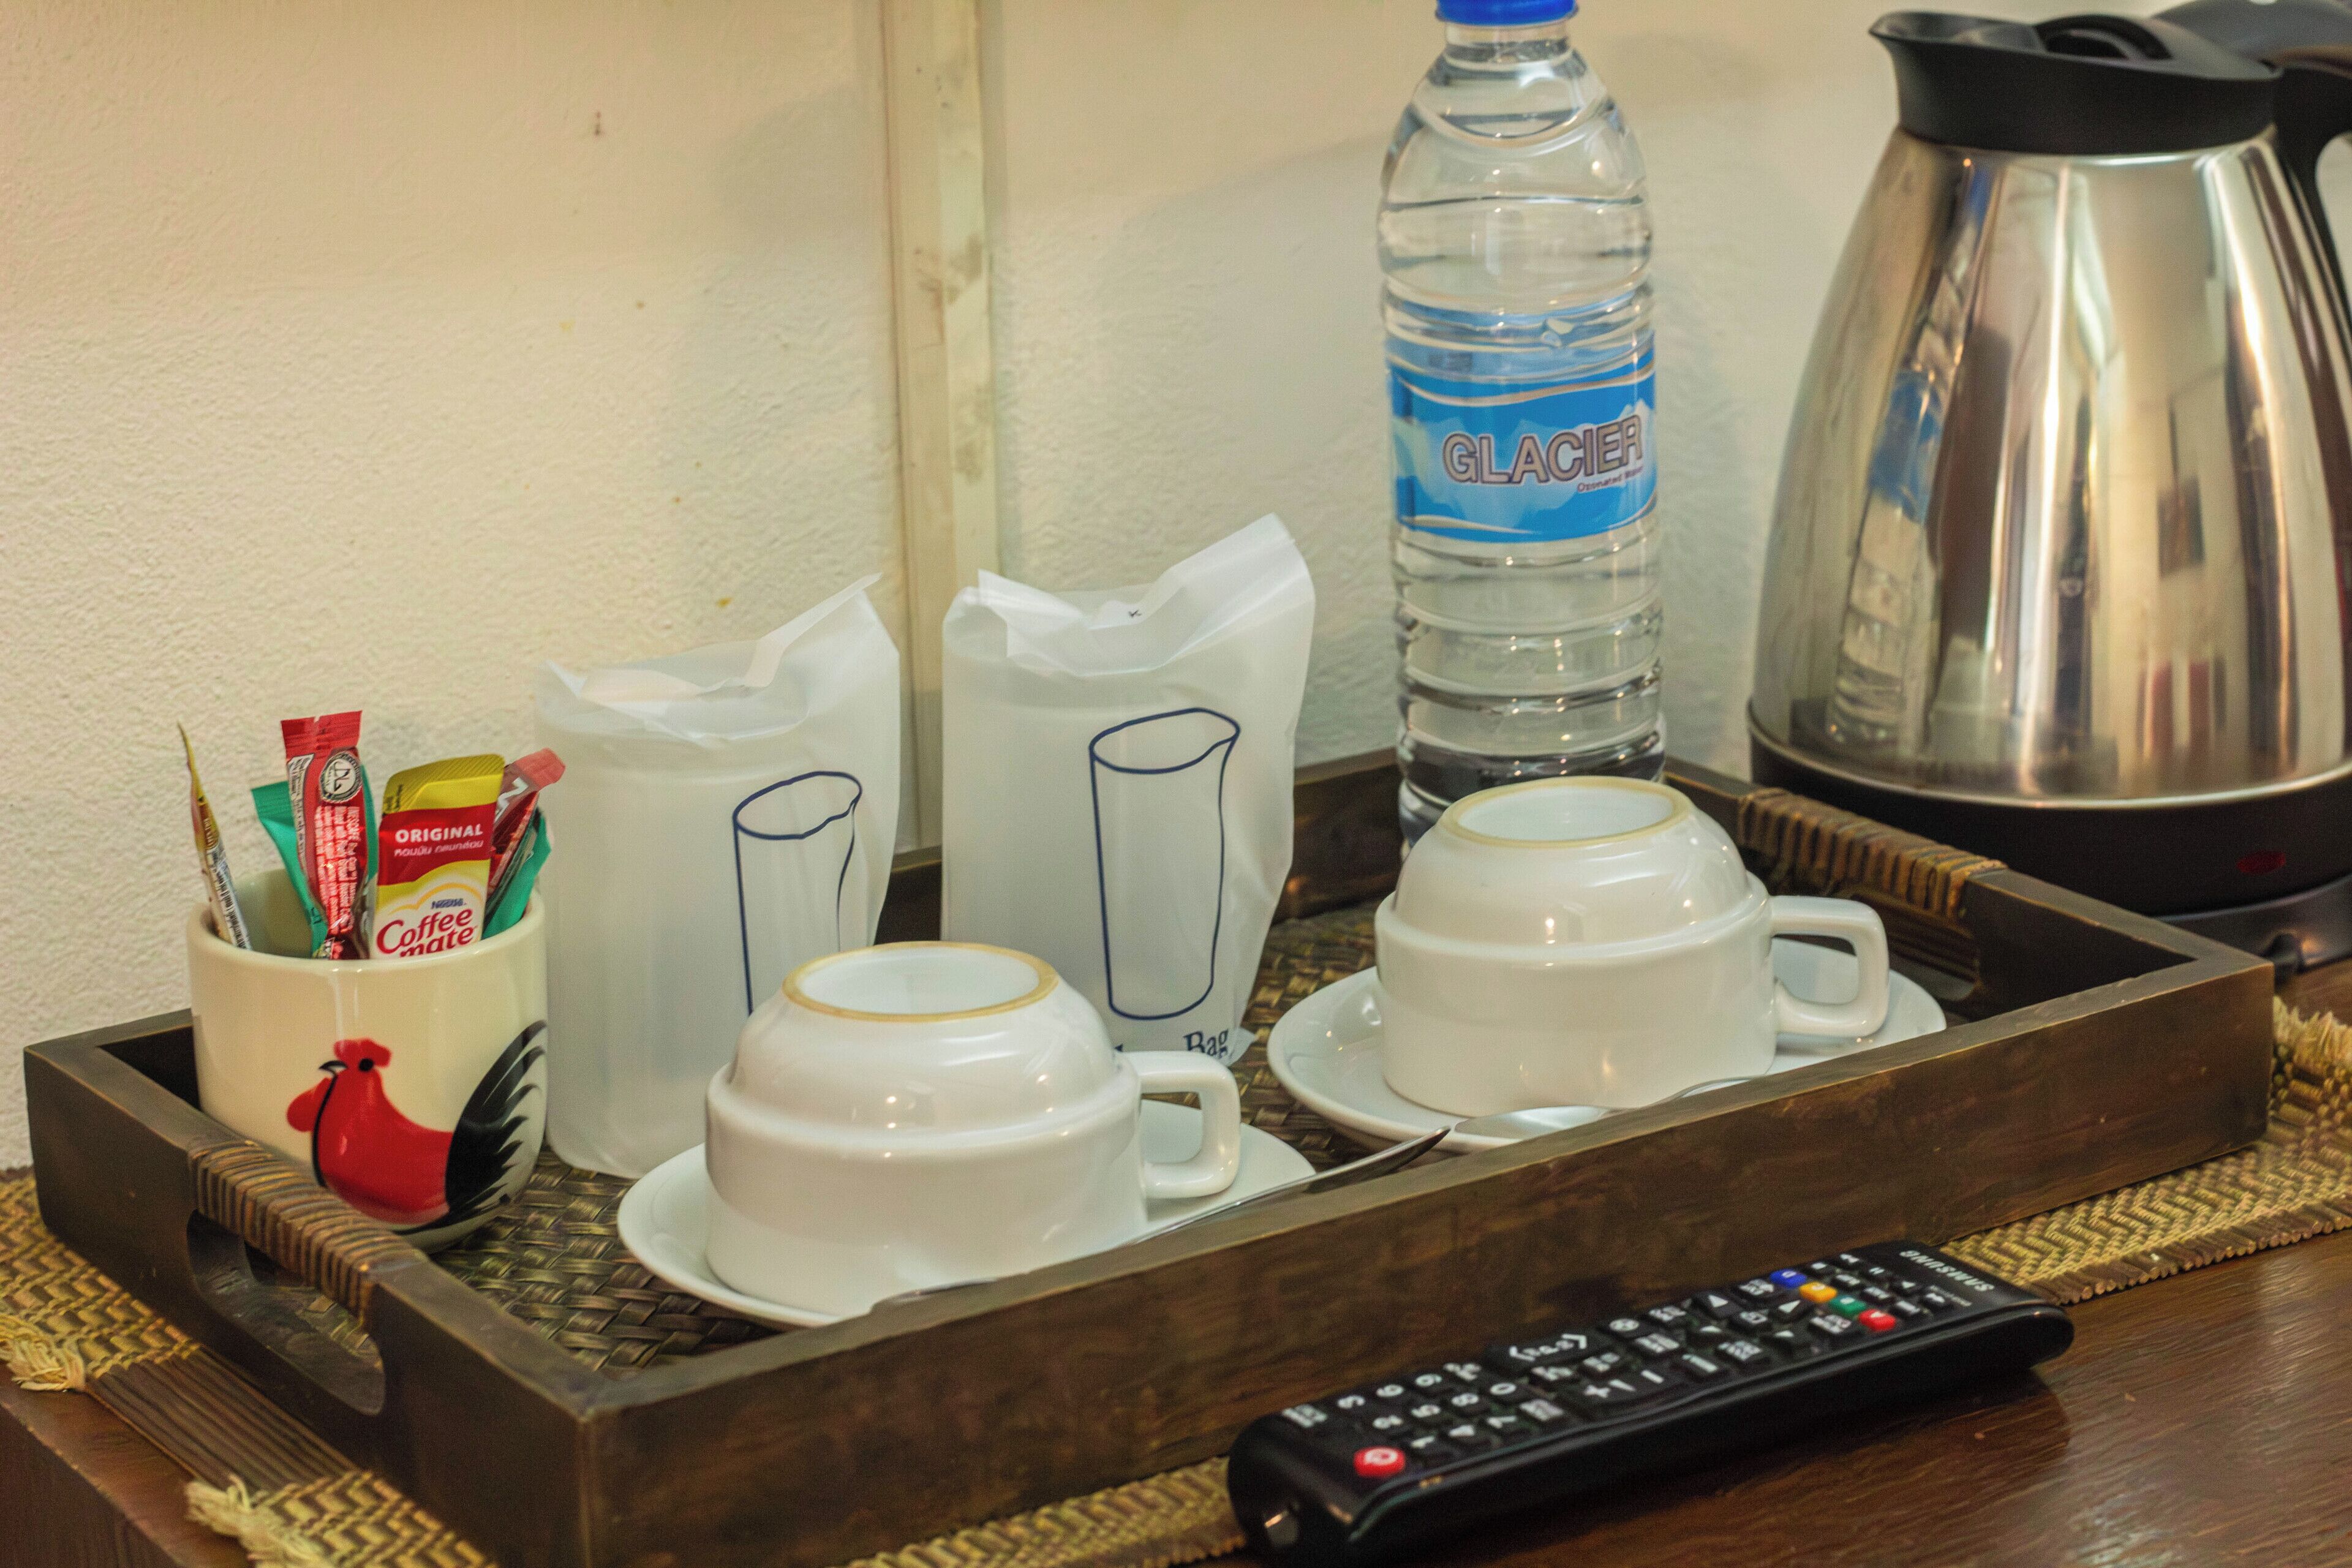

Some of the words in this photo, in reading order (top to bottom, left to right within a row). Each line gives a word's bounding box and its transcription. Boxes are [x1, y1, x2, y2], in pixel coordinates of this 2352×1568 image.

[1442, 415, 1643, 484] GLACIER
[394, 823, 484, 843] ORIGINAL
[376, 908, 473, 954] Coffee
[399, 926, 475, 958] mate
[1183, 1028, 1229, 1059] Bag
[1899, 1250, 1995, 1293] SAMSUNG
[1490, 1382, 1517, 1395] 0
